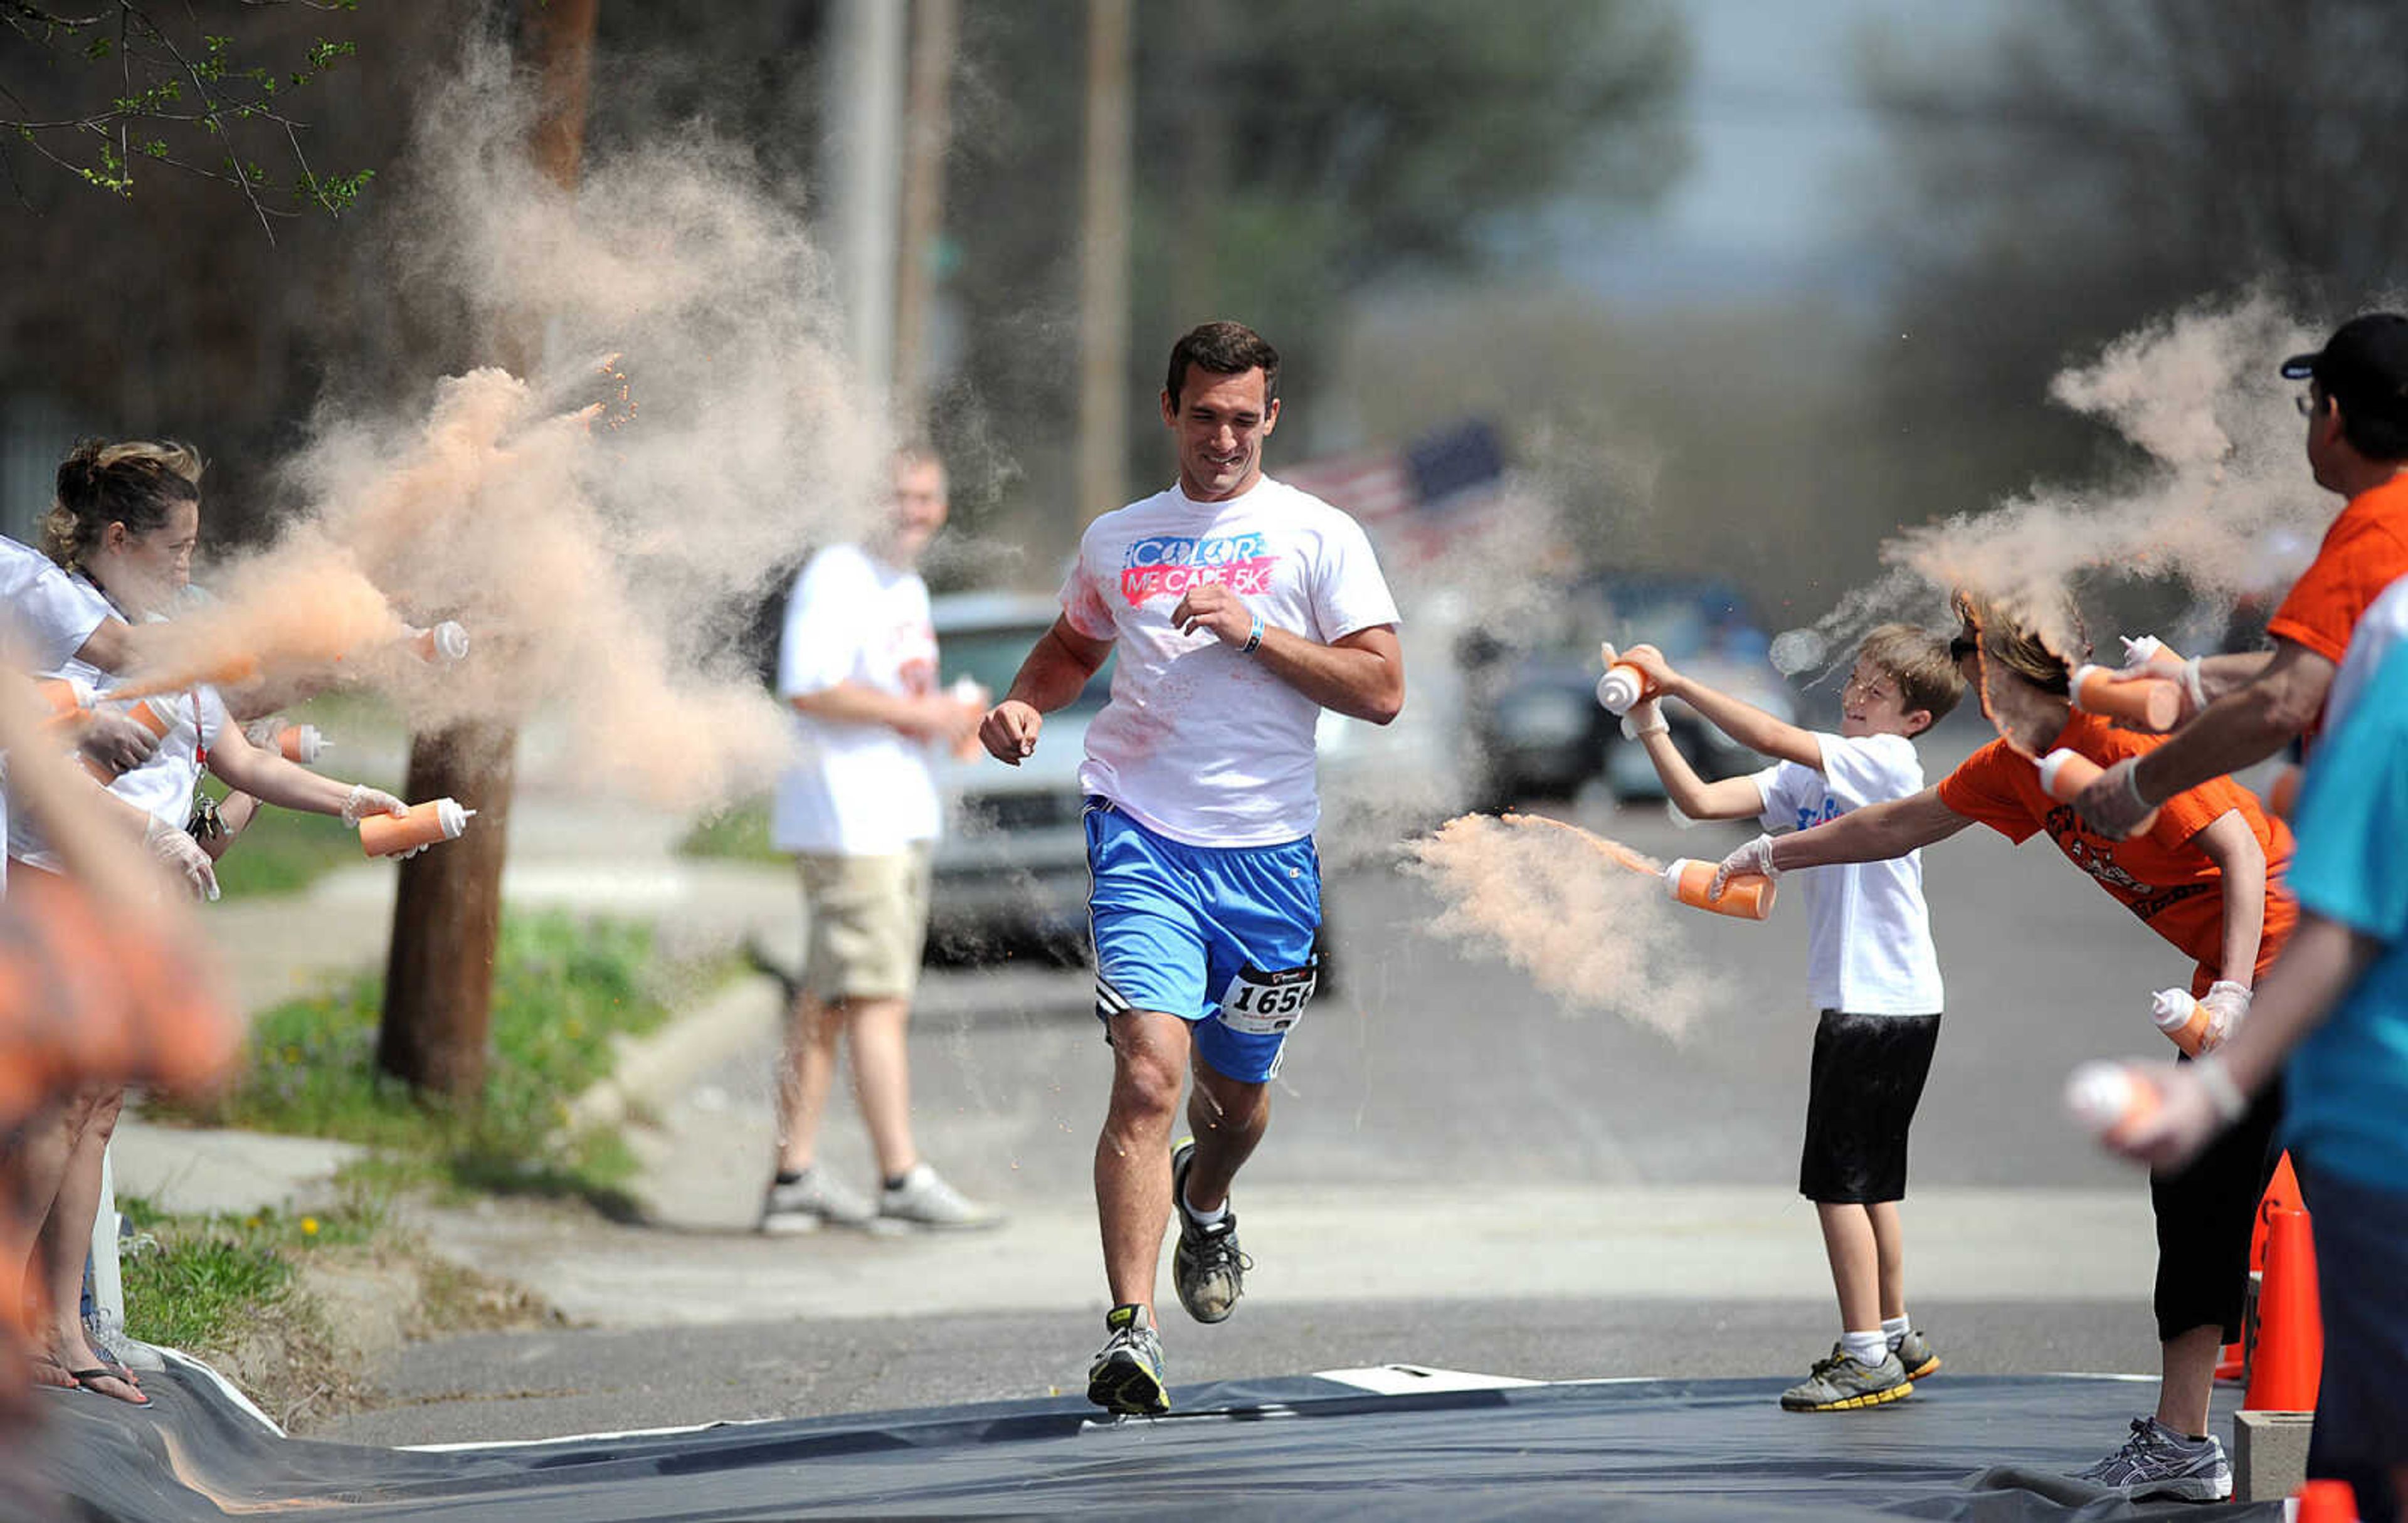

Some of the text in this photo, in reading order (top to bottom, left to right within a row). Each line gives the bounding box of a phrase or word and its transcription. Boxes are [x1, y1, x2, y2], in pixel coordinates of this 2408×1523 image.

[1133, 538, 1255, 566] COLOR
[1128, 571, 1159, 591] ME
[1233, 569, 1267, 591] 5K
